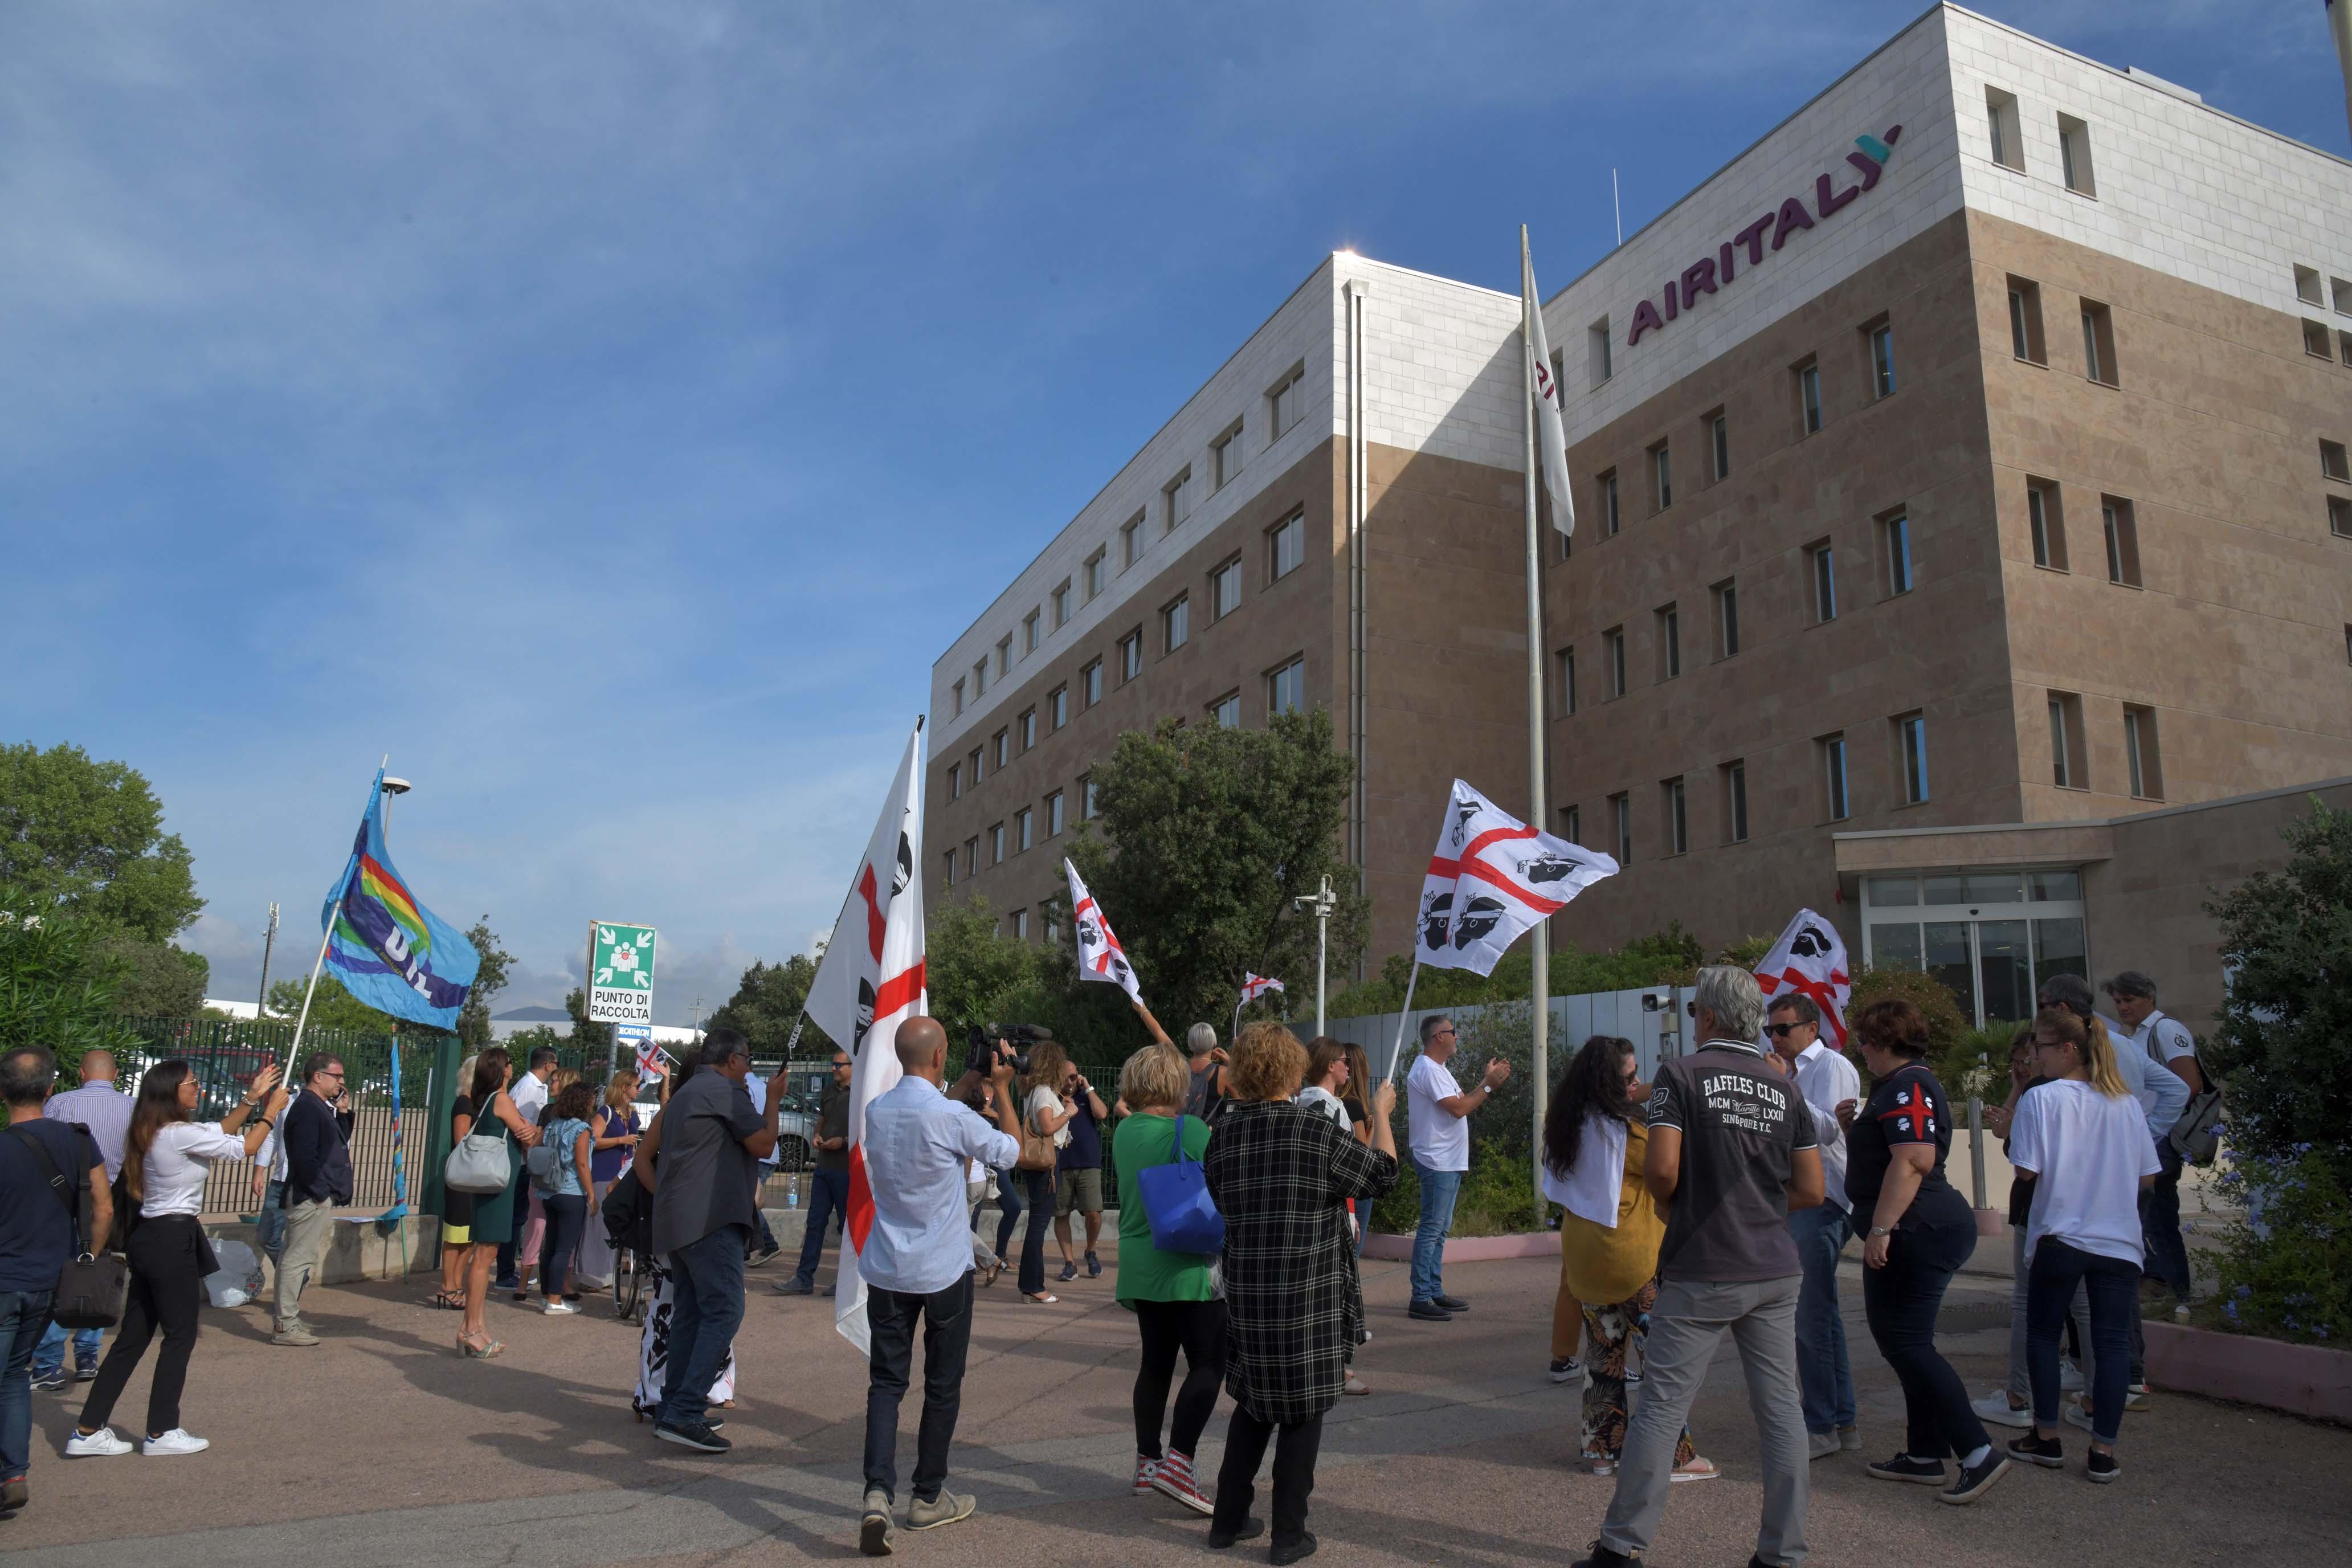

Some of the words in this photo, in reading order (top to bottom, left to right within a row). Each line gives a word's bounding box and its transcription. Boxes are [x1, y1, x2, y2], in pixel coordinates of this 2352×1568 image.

[1628, 124, 1902, 346] AIRITALY
[595, 991, 632, 1004] PUNTO
[636, 994, 647, 1005] DI
[591, 1005, 649, 1019] RACCOLTA
[1703, 1075, 1753, 1096] RAFFLES
[1757, 1082, 1786, 1110] CLUB
[1708, 1097, 1730, 1109] MCM
[1763, 1107, 1784, 1122] LXXII
[1759, 1122, 1772, 1133] Y.C.
